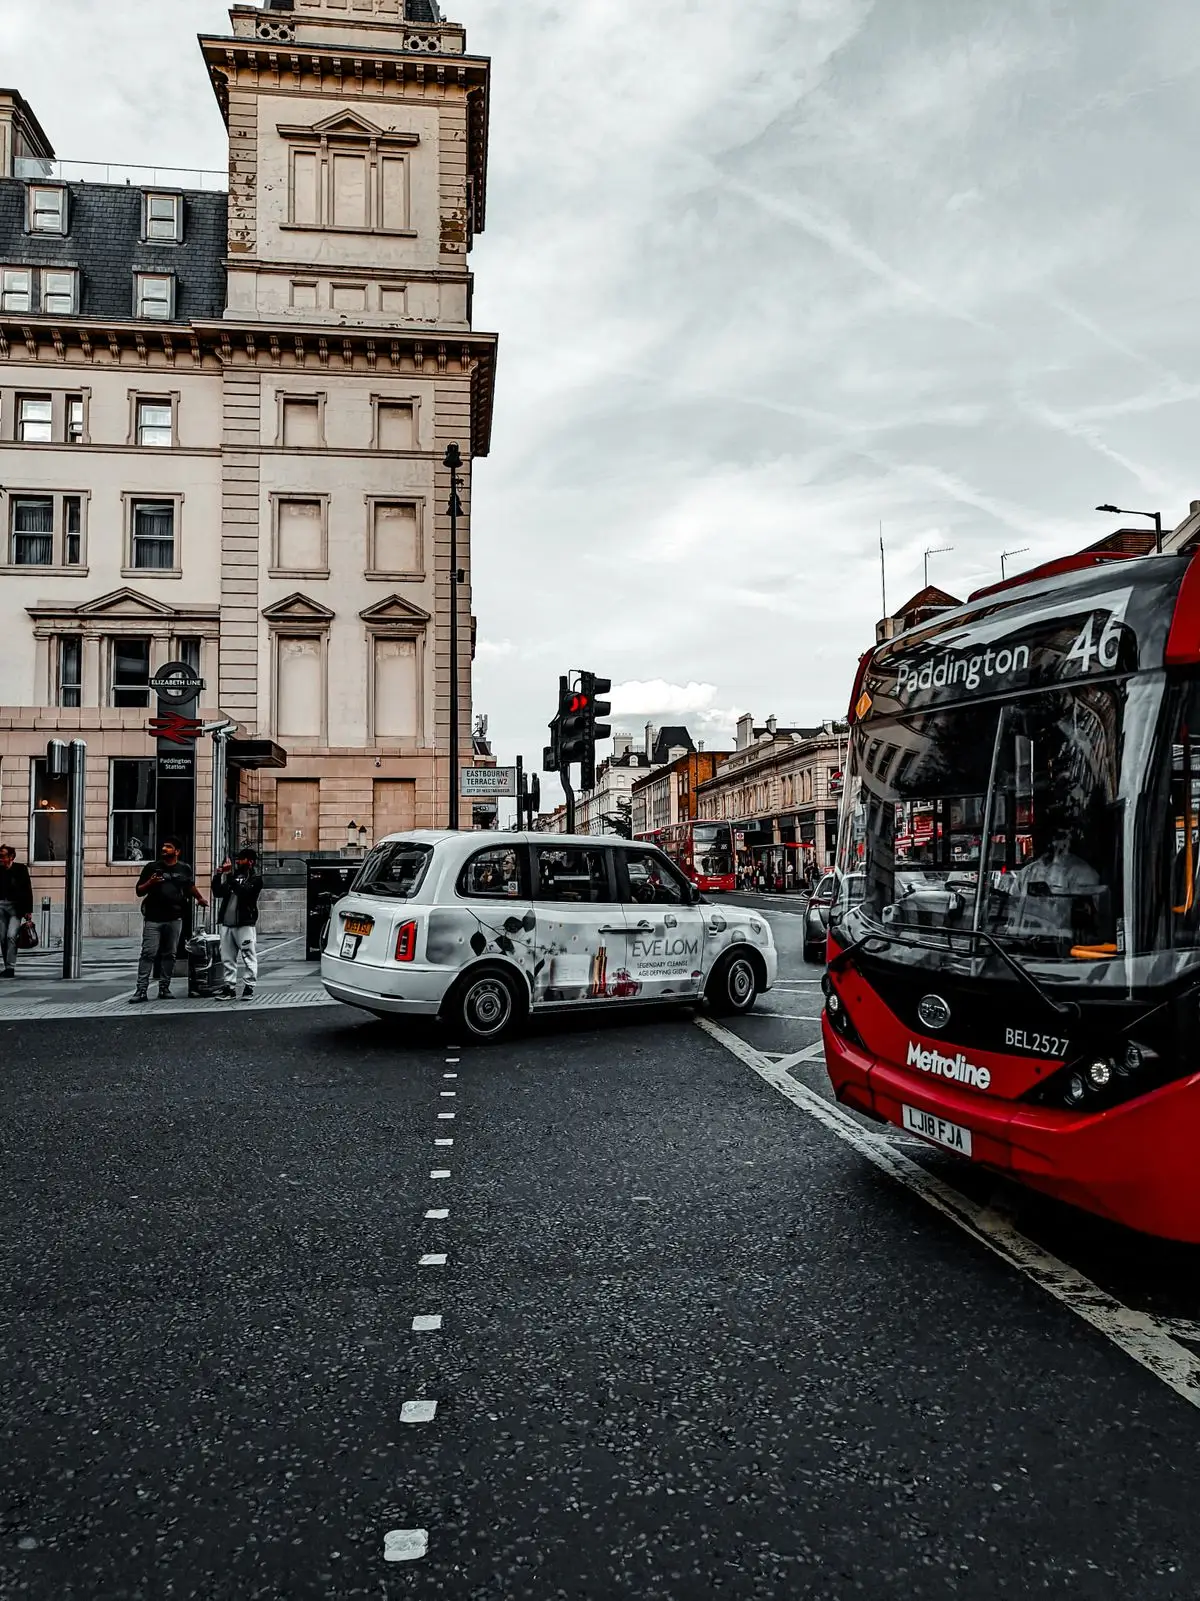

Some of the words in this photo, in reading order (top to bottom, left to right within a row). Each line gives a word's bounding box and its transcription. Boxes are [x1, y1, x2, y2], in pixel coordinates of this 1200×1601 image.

[896, 645, 1029, 694] Paddington
[1065, 611, 1122, 672] 46
[632, 940, 662, 957] EVE
[664, 939, 698, 956] LOM
[1005, 1028, 1070, 1057] BEL2527
[906, 1040, 991, 1090] Metroline
[908, 1109, 935, 1136] LJ18
[938, 1121, 963, 1149] FJA
